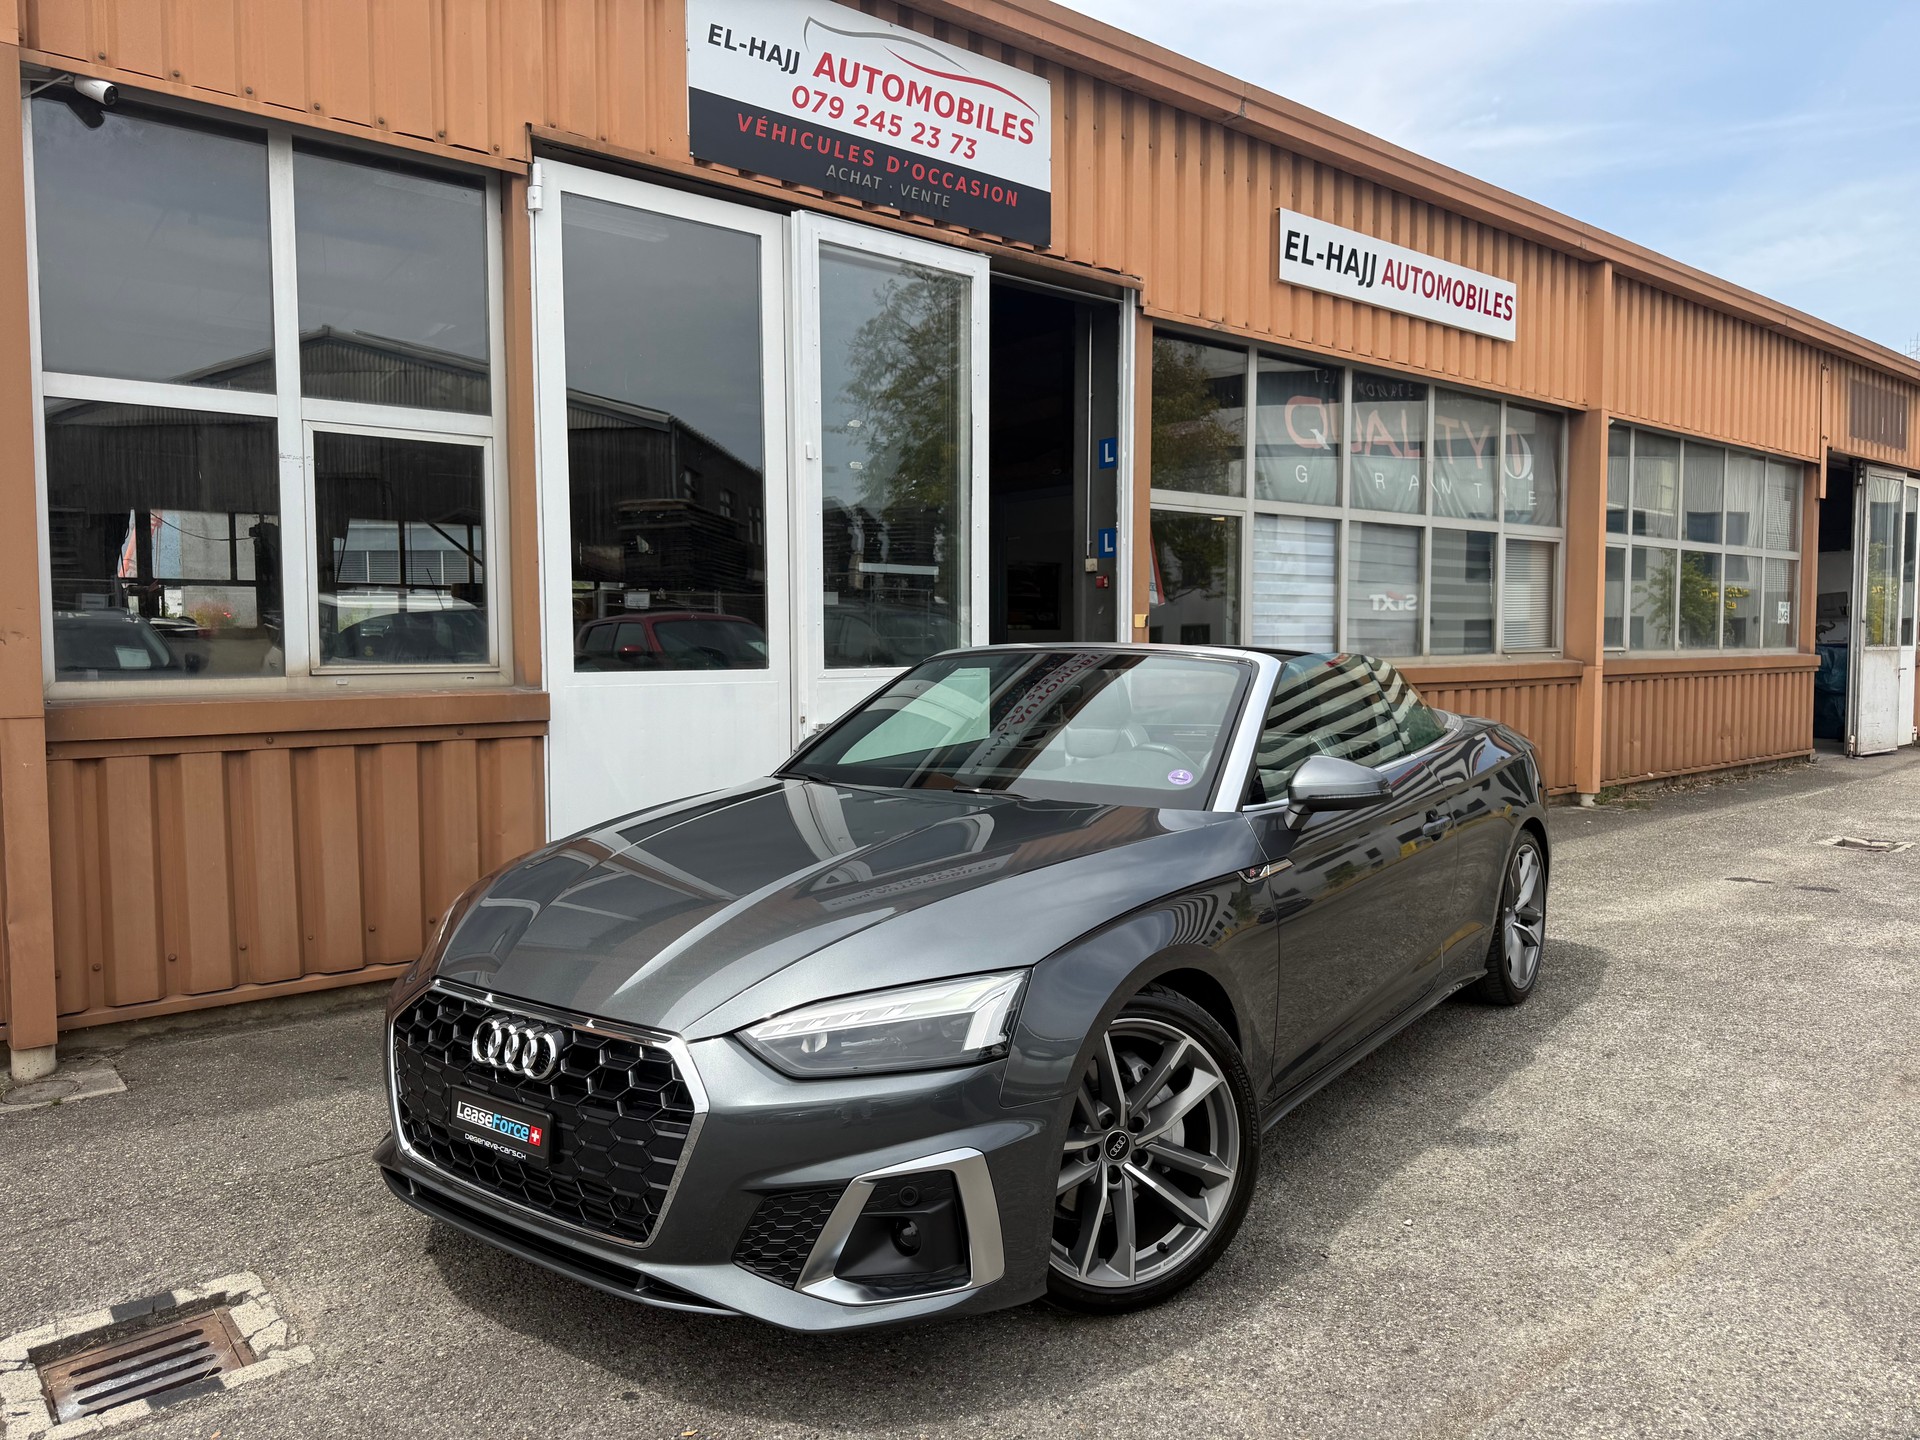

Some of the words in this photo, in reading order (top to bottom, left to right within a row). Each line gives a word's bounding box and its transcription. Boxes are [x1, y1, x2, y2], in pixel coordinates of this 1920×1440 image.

[708, 23, 800, 75] EL-HAJJ
[812, 51, 1034, 145] AUTOMOBILES
[737, 112, 875, 167] VÉHICULES
[791, 85, 845, 119] 079
[853, 104, 903, 137] 245
[910, 122, 942, 149] 23
[949, 132, 978, 160] 73
[825, 164, 883, 190] ACHAT
[900, 183, 951, 208] VENTE
[1284, 229, 1377, 288] EL-HAJJ
[1381, 258, 1514, 321] AUTOMOBILES
[1104, 443, 1114, 463] L
[1284, 394, 1491, 470] QUALTY
[1104, 533, 1114, 552] L
[456, 1101, 530, 1140] LeaseForce
